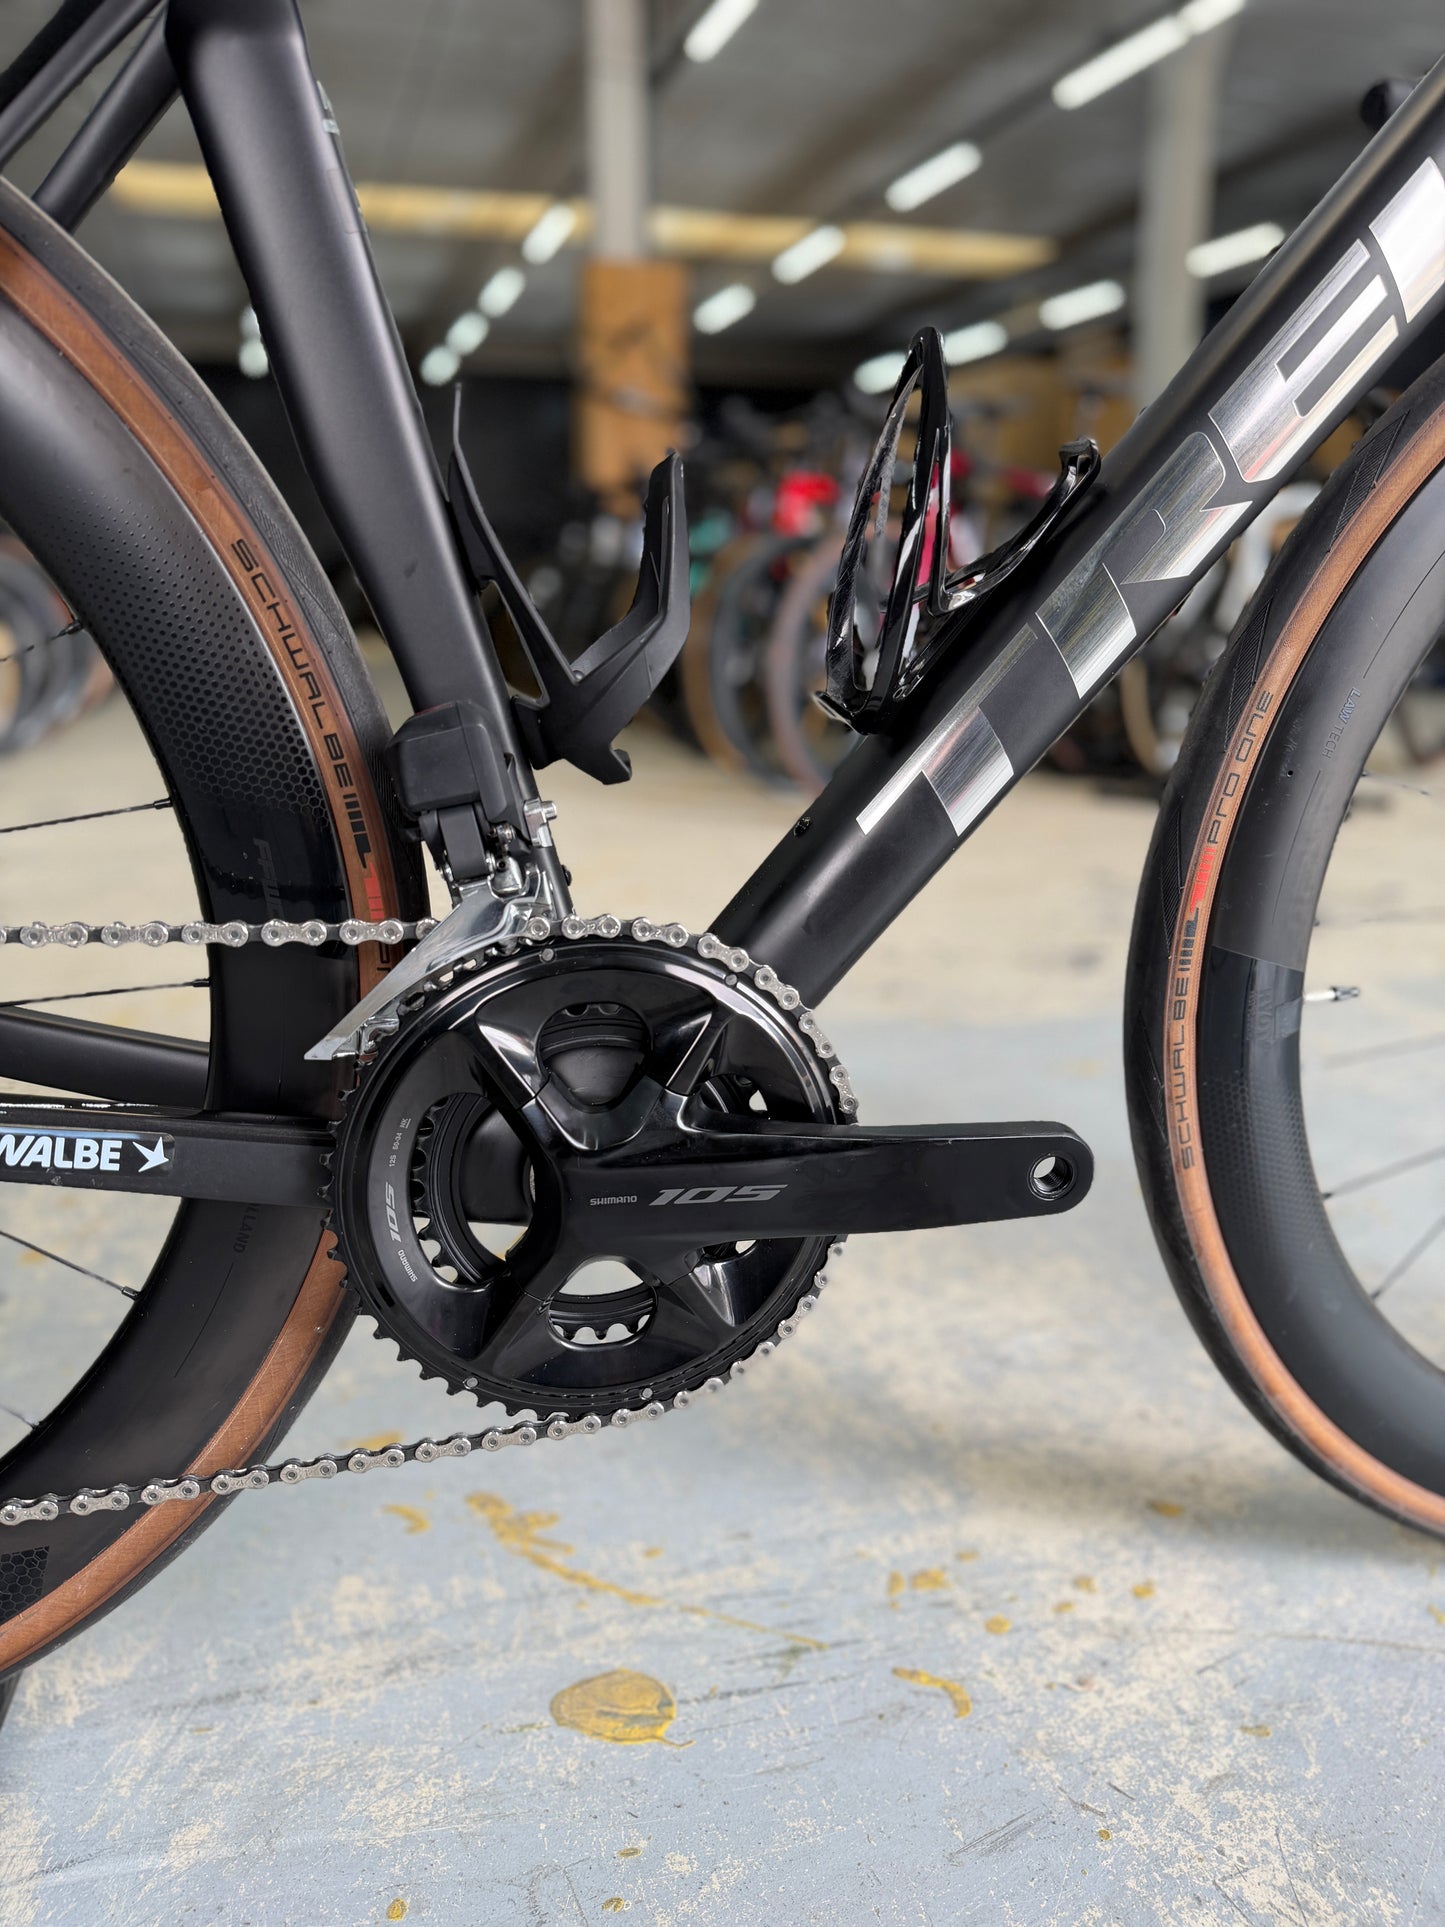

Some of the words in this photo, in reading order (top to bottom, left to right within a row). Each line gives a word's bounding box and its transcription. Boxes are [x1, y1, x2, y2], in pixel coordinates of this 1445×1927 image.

[231, 539, 354, 788] SCHWALBE
[1172, 978, 1196, 1170] SCHWALBE
[385, 1181, 402, 1243] 105
[589, 1195, 638, 1206] SHIMANO
[649, 1184, 789, 1206] 105
[397, 1249, 418, 1283] SHIMANO
